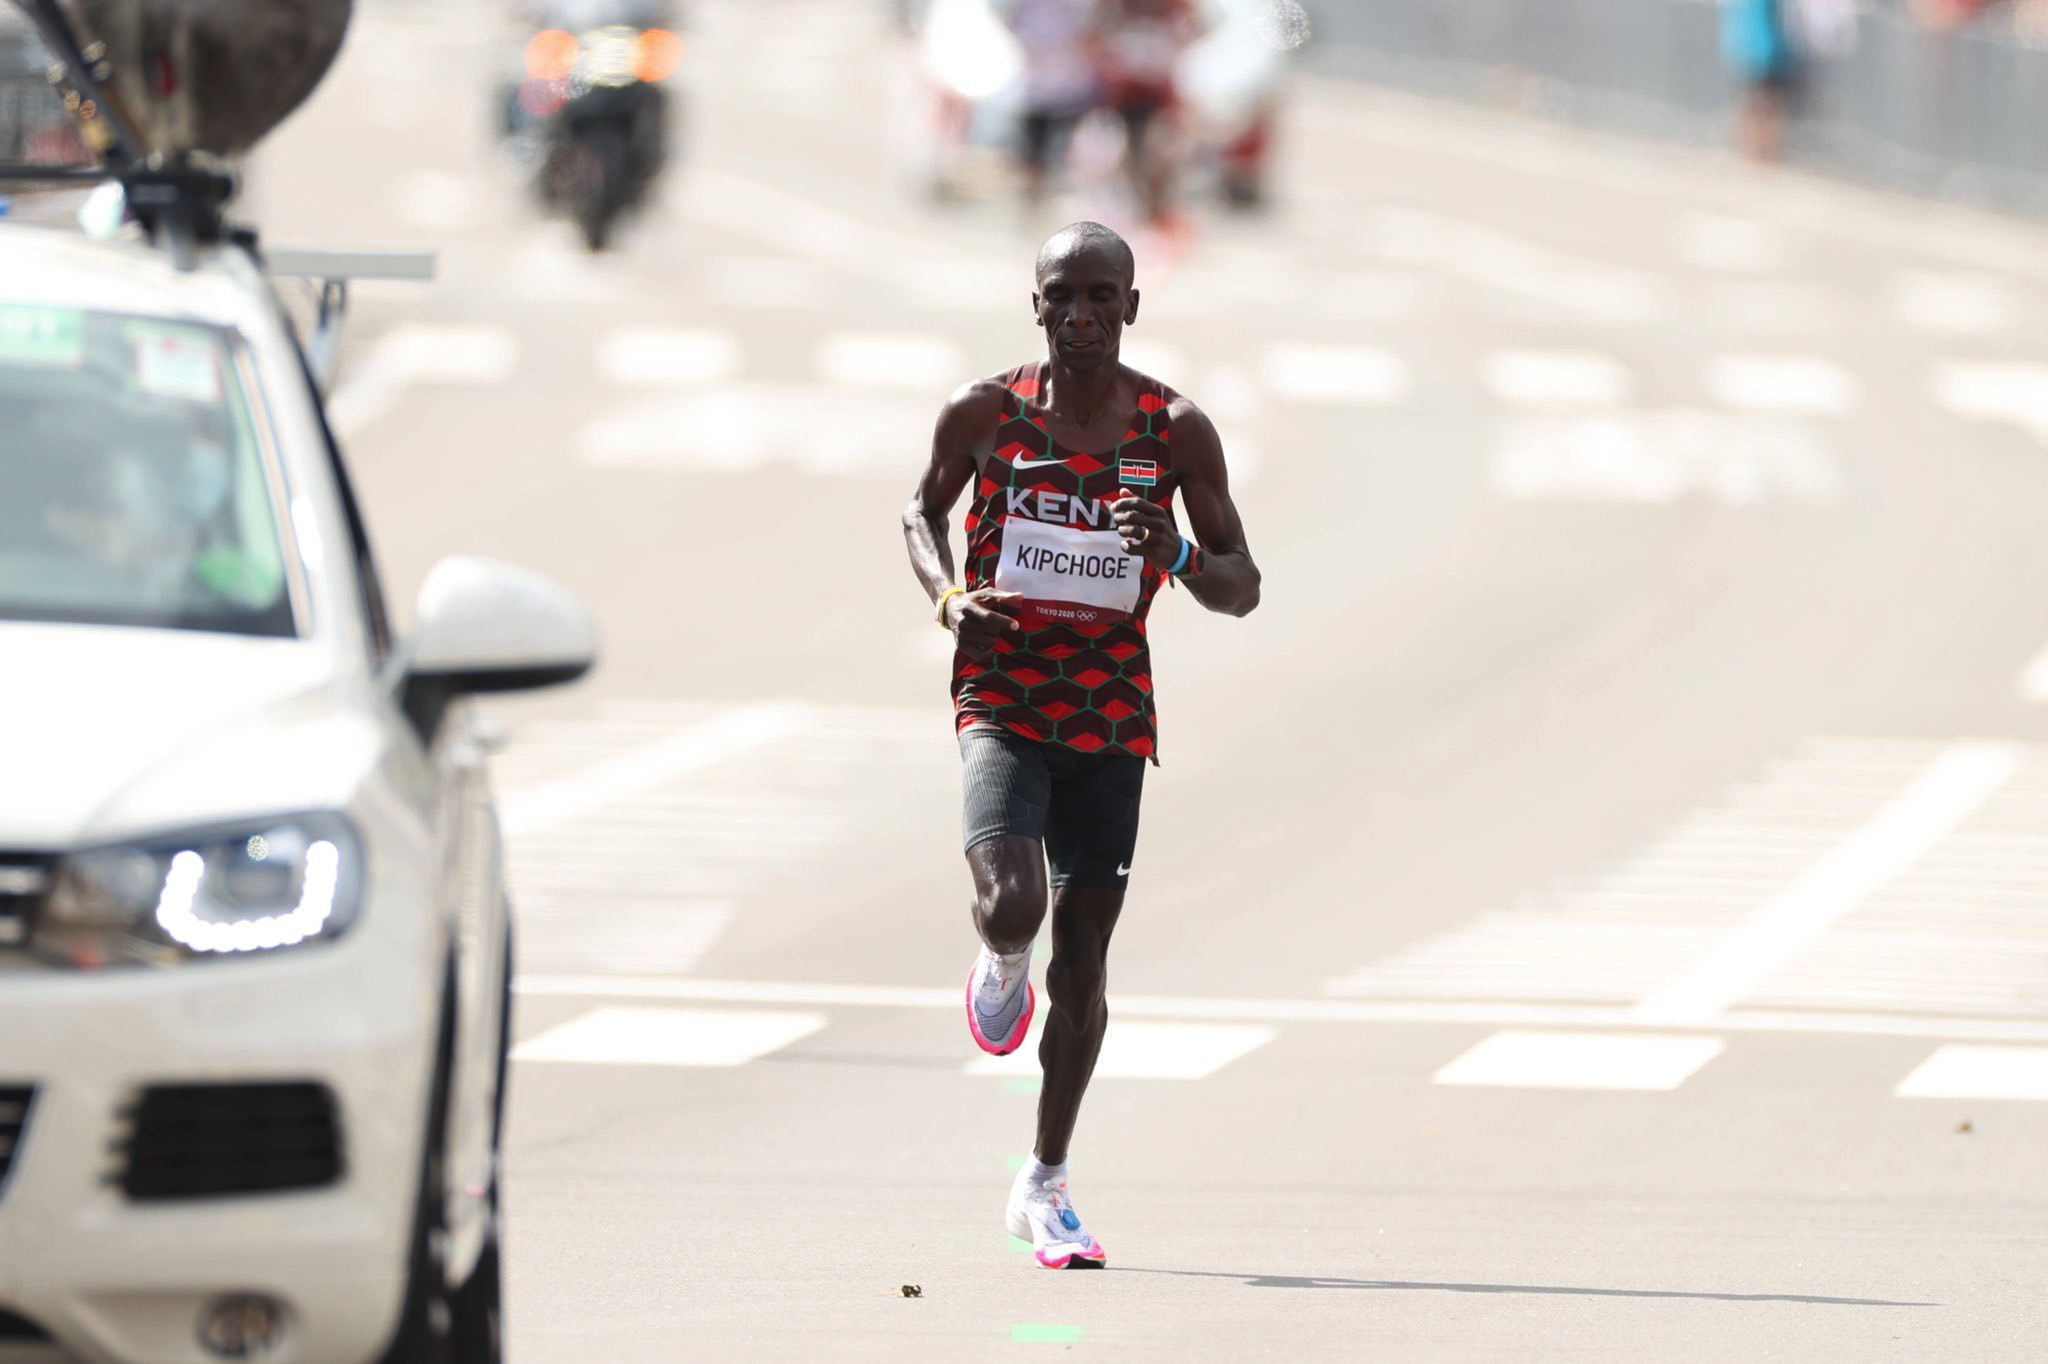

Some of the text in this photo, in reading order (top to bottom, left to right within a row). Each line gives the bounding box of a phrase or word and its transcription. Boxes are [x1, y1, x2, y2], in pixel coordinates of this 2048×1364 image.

[1007, 486, 1118, 529] KENY
[1016, 544, 1130, 579] KIPCHOGE
[1035, 606, 1075, 619] TOKYO 2020
